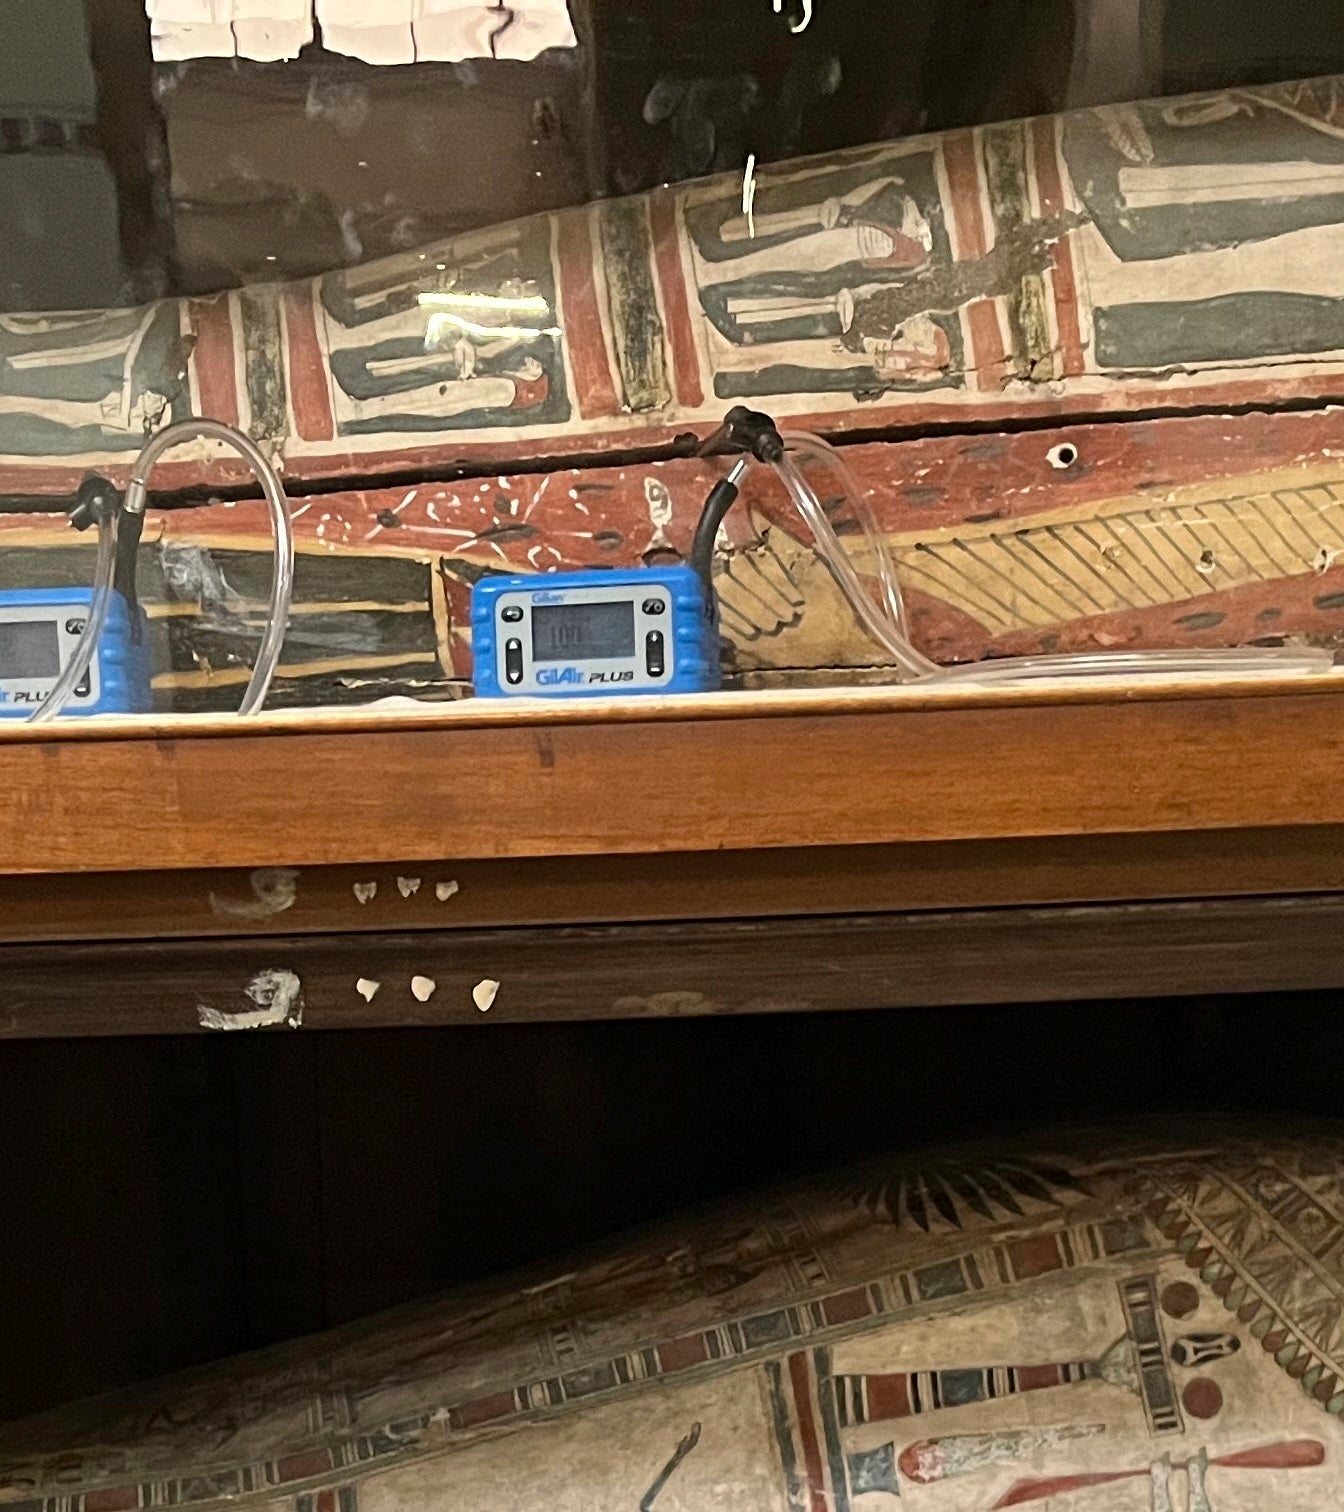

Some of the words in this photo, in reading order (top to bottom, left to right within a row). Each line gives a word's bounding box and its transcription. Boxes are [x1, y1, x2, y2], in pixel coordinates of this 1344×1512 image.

[536, 667, 584, 686] GilAir
[588, 671, 634, 684] PLUS
[13, 691, 52, 703] PLU
